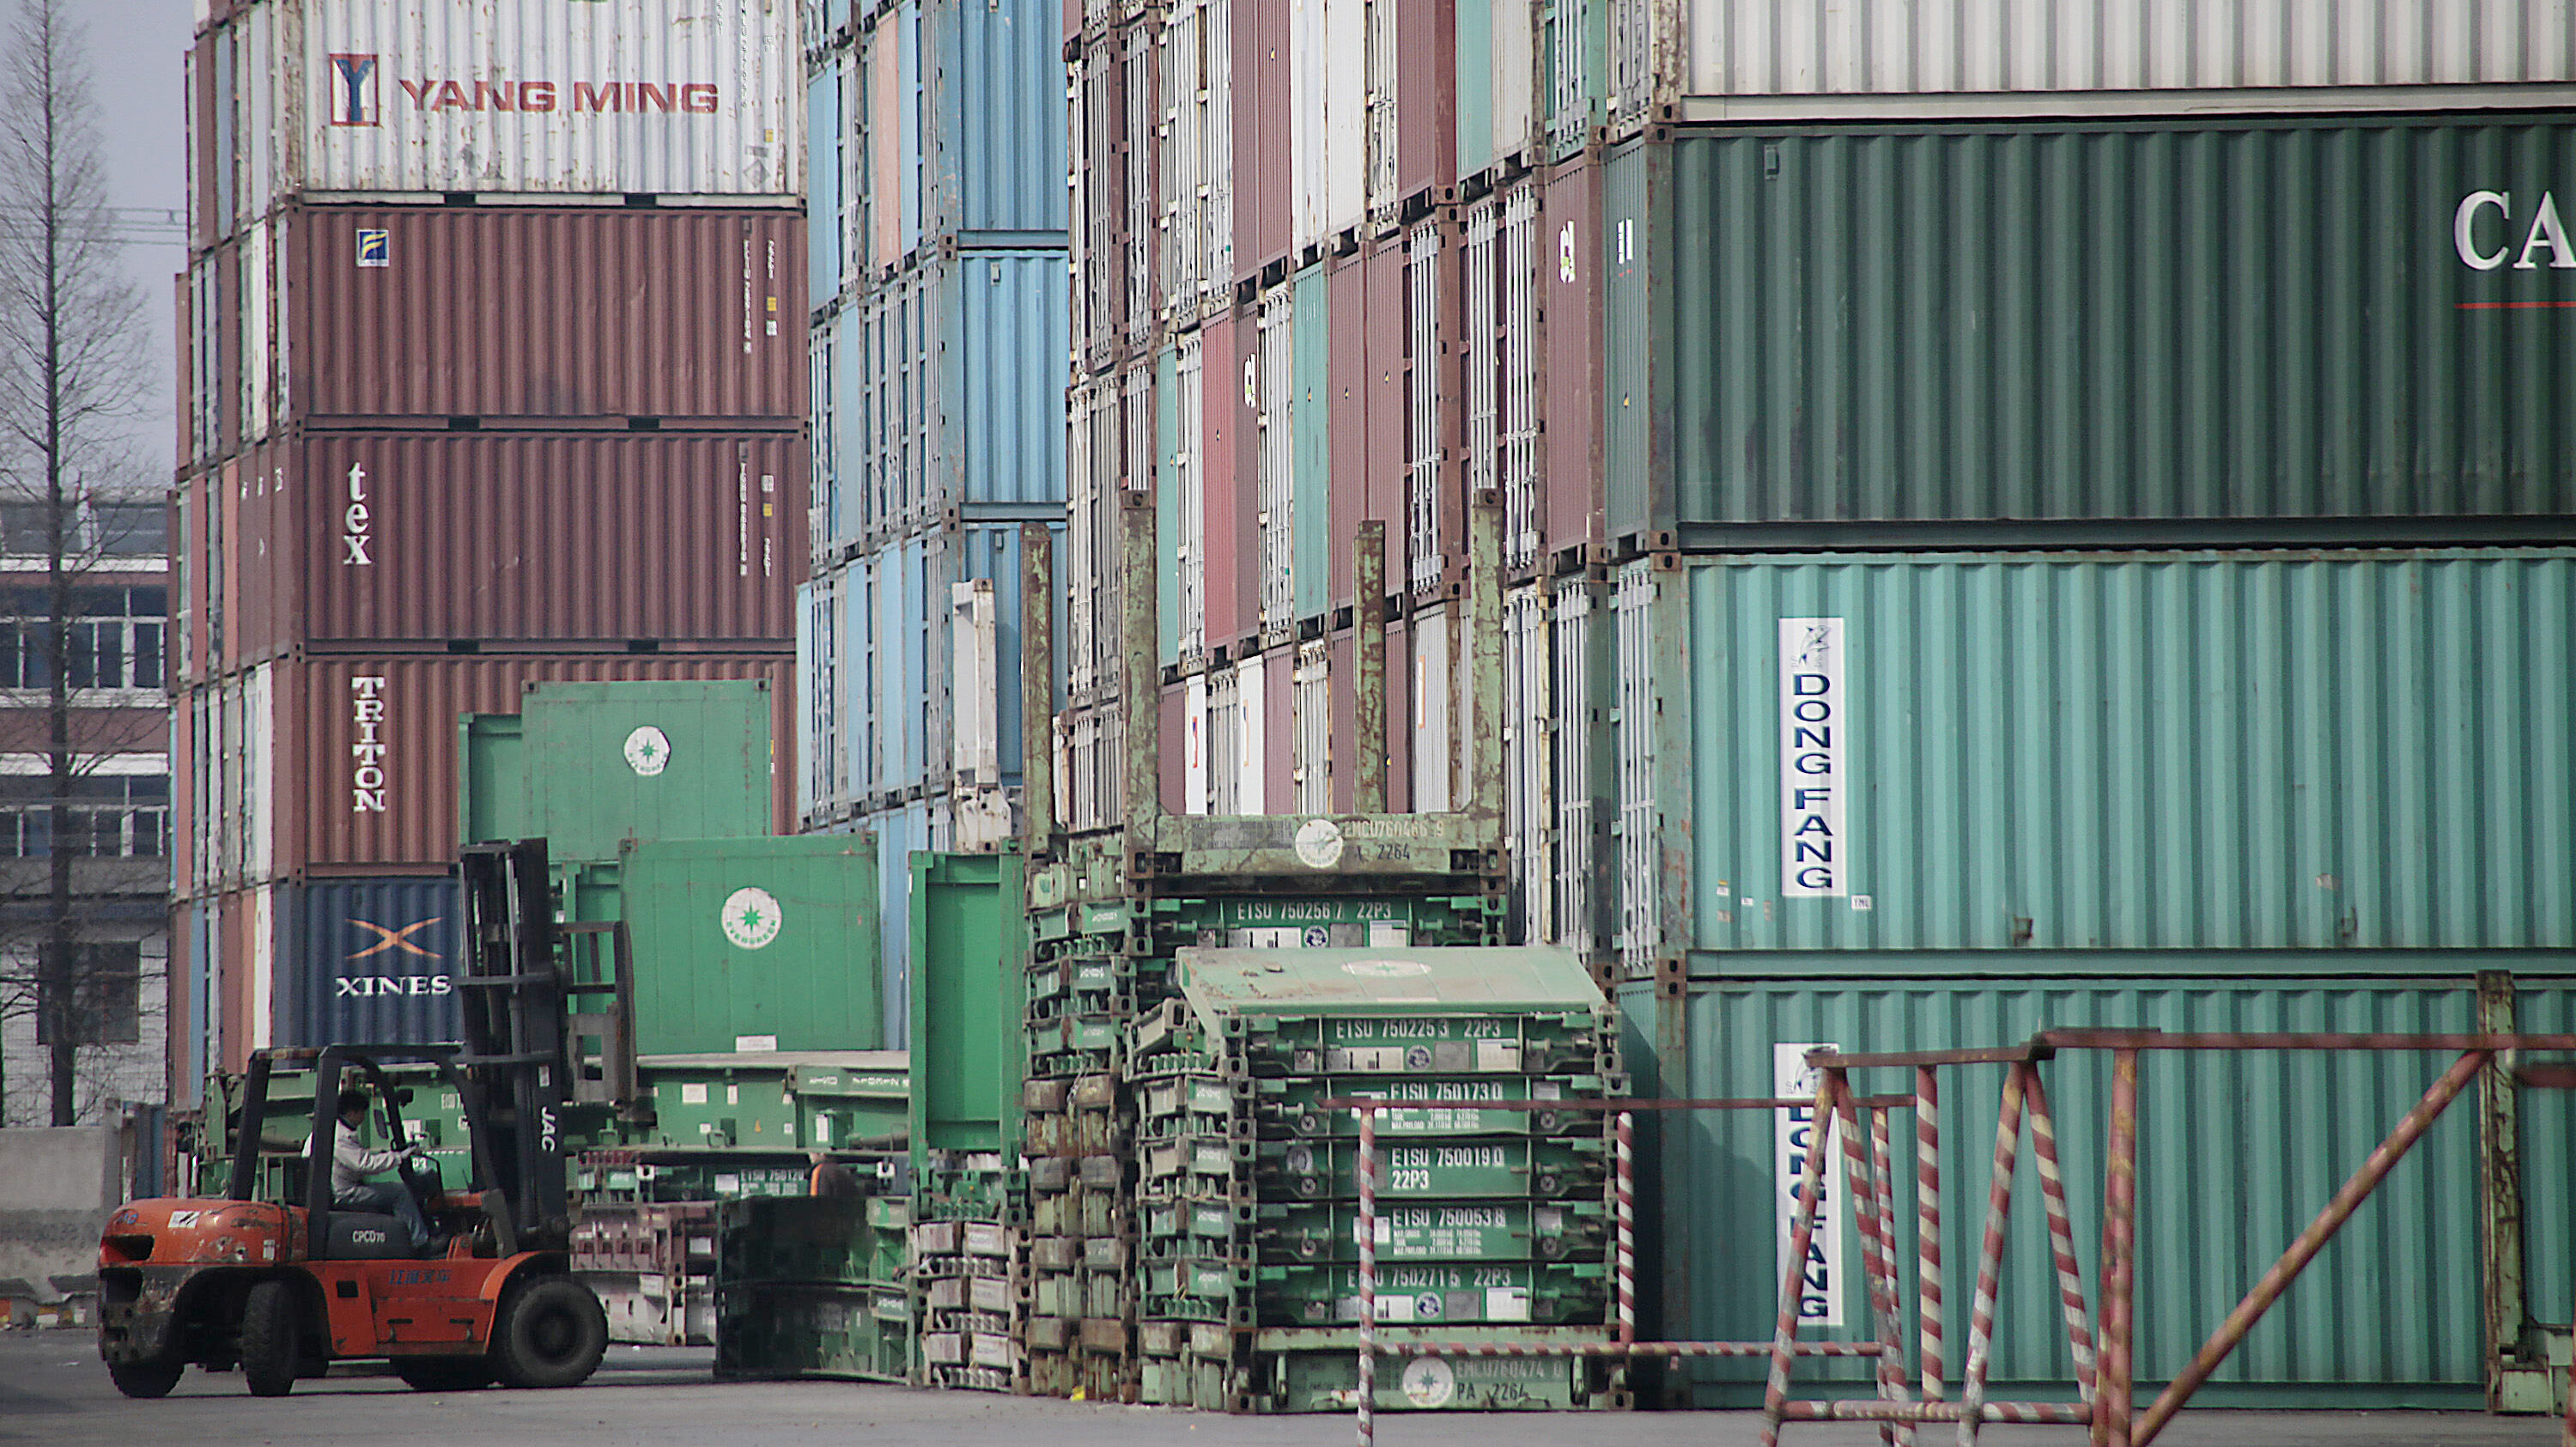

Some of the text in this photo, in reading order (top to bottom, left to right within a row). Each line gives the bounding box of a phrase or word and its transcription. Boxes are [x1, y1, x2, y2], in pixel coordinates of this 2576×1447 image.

[399, 80, 720, 114] YANG MING
[343, 462, 373, 565] tex
[1793, 673, 1832, 775] DONG
[351, 677, 386, 812] TRITON
[1794, 787, 1833, 889] FANG
[1377, 843, 1410, 860] 2264
[1237, 902, 1273, 920] EISU
[1357, 902, 1392, 919] 22P3
[335, 976, 453, 998] XINES
[1336, 1020, 1373, 1039] EISU
[1382, 1020, 1435, 1038] 750225
[1463, 1020, 1502, 1037] 22P3
[1390, 1083, 1429, 1100] EISU
[541, 1105, 557, 1152] JAC
[1391, 1147, 1430, 1167] EISU
[1392, 1170, 1431, 1190] 22P3
[1393, 1208, 1431, 1227] EISU
[352, 1230, 386, 1243] CPCD70
[1347, 1268, 1384, 1287] EU
[1473, 1268, 1511, 1286] 22P3
[1456, 1383, 1476, 1401] PA
